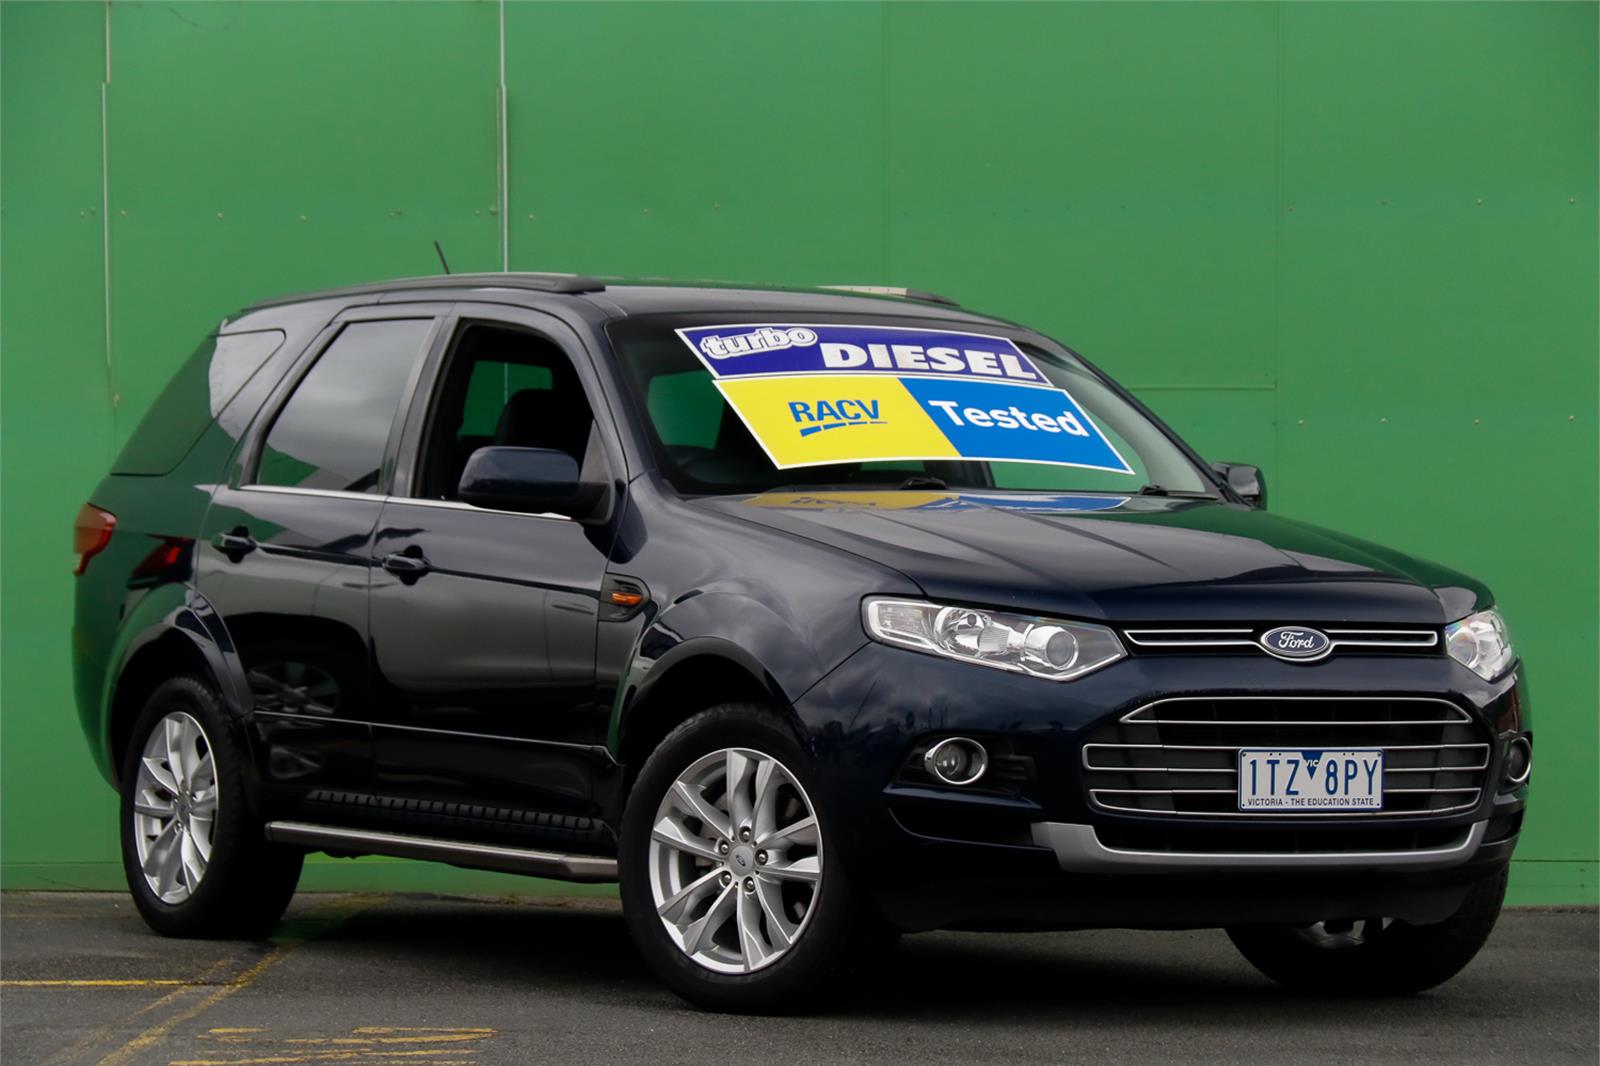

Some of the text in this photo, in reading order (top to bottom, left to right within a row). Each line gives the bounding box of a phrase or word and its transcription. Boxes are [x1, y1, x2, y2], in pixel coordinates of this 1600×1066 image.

[701, 327, 818, 359] turbo
[819, 342, 1037, 379] DIESEL
[788, 399, 879, 423] RACV
[928, 400, 1090, 437] Tested
[1278, 631, 1315, 649] Ford
[1305, 759, 1320, 768] VIC
[1247, 798, 1284, 806] VICTORIA
[1291, 798, 1306, 806] THE
[1307, 798, 1351, 806] EDUCATION
[1352, 798, 1375, 806] STATE
